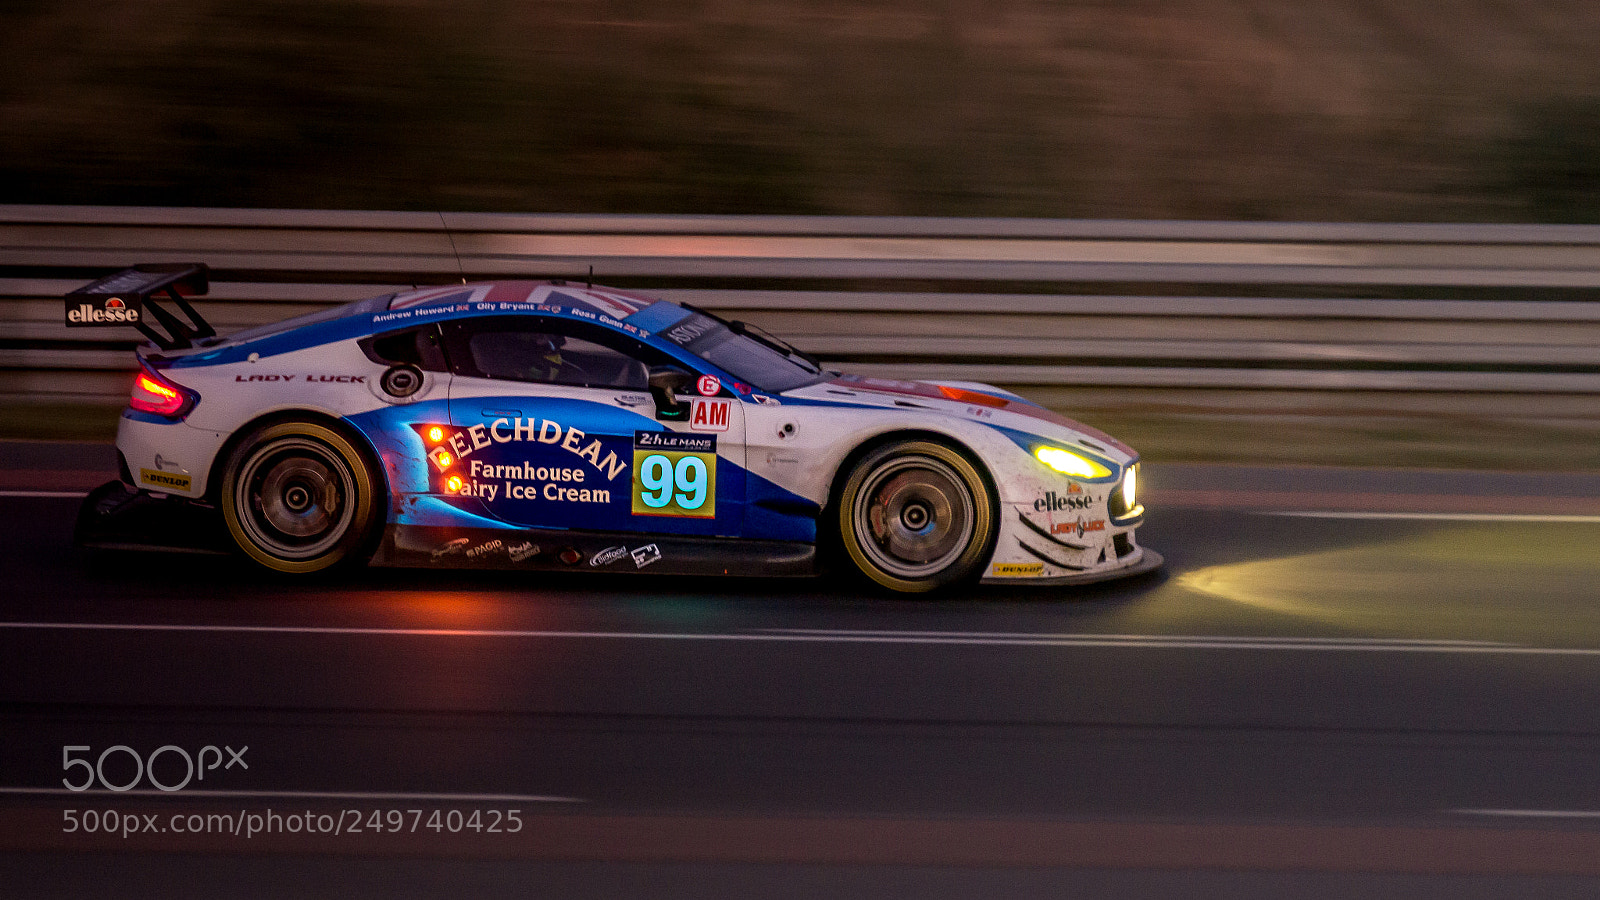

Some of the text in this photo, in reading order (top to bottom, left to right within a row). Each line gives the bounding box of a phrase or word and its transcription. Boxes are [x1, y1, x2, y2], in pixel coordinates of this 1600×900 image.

[68, 304, 139, 322] ellesse
[373, 305, 454, 323] Andrew Howard
[476, 302, 535, 311] Olly Bryant
[571, 307, 624, 329] Ross Gunn
[235, 373, 367, 383] LADY LUCK
[694, 402, 727, 426] AM
[428, 417, 627, 481] BEECHDEAN
[664, 437, 678, 446] LE
[679, 438, 712, 447] MANS
[470, 459, 586, 483] Farmhouse
[150, 474, 189, 487] DUNLOP
[640, 454, 708, 510] 99
[505, 480, 537, 500] Ice
[543, 483, 611, 503] Cream
[1034, 491, 1093, 512] ellesse
[1051, 519, 1105, 534] LADY LUCK
[1001, 565, 1043, 573] DUNLOP
